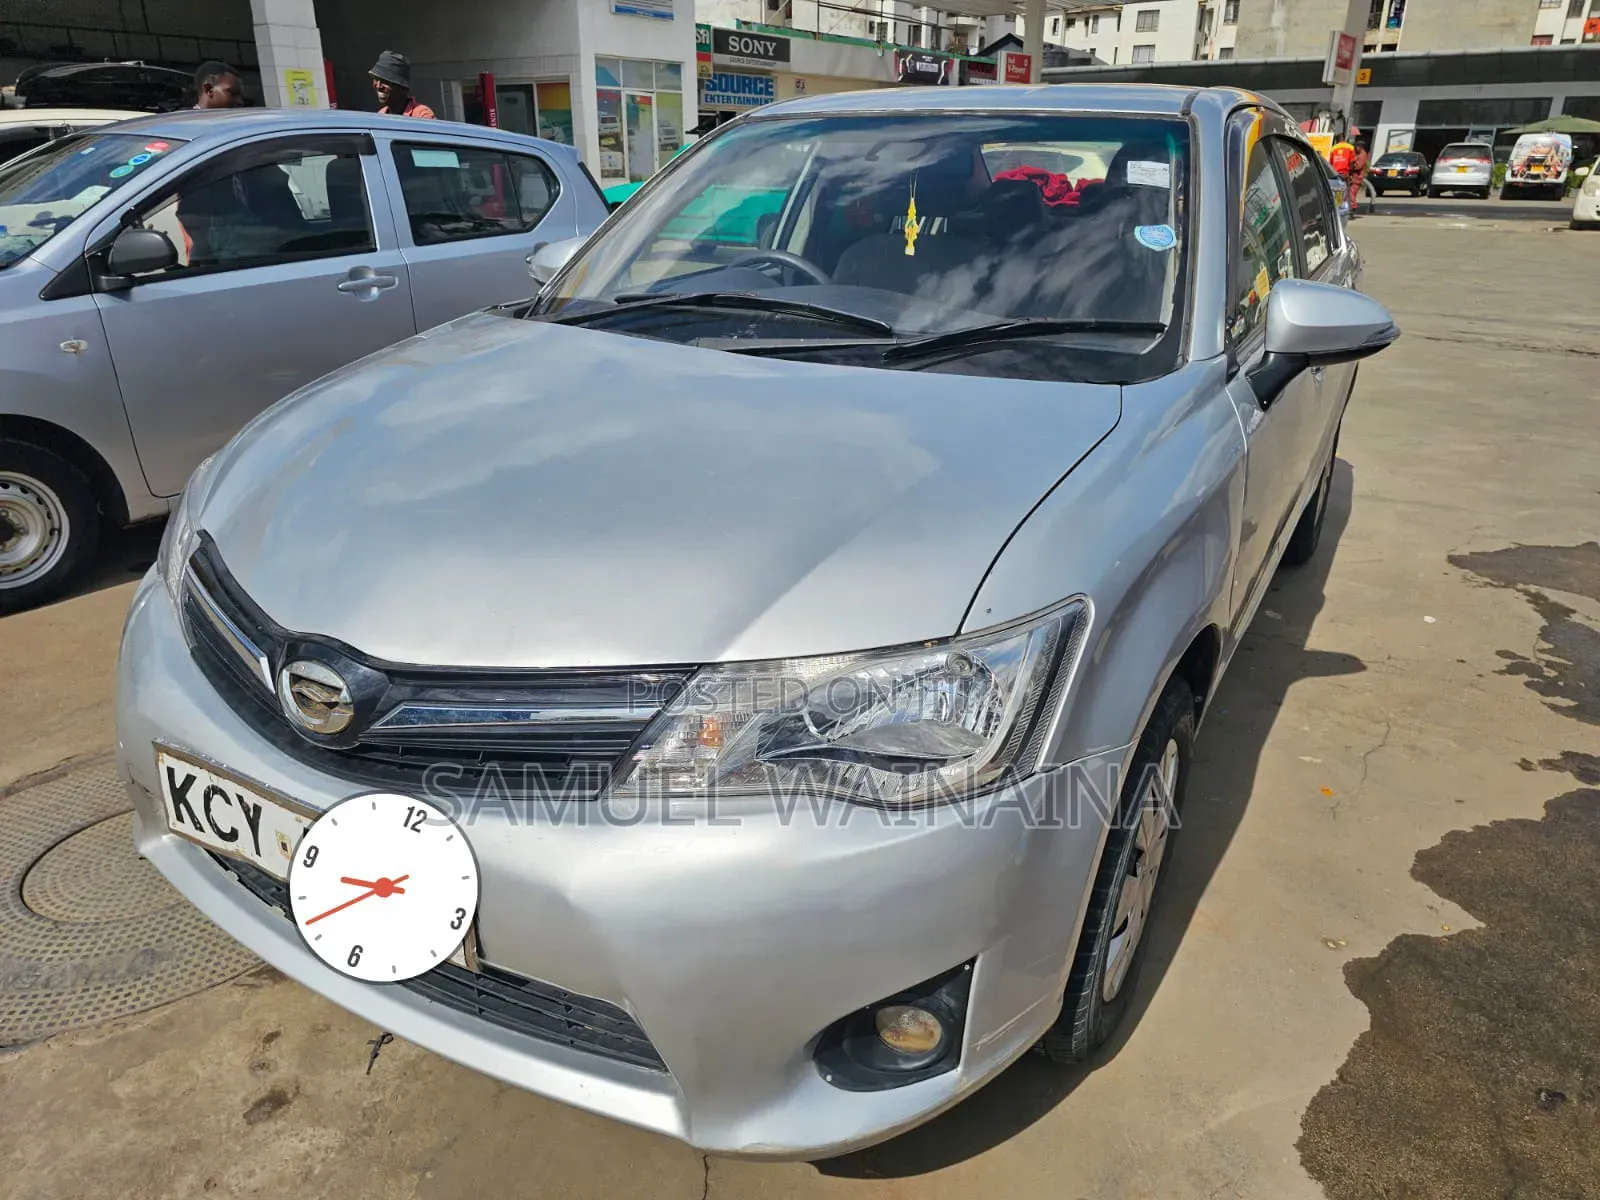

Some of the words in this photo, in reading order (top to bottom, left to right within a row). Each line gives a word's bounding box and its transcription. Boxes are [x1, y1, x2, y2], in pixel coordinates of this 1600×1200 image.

[728, 35, 776, 56] SONY
[704, 73, 775, 97] SOURCE
[165, 765, 264, 858] KCY
